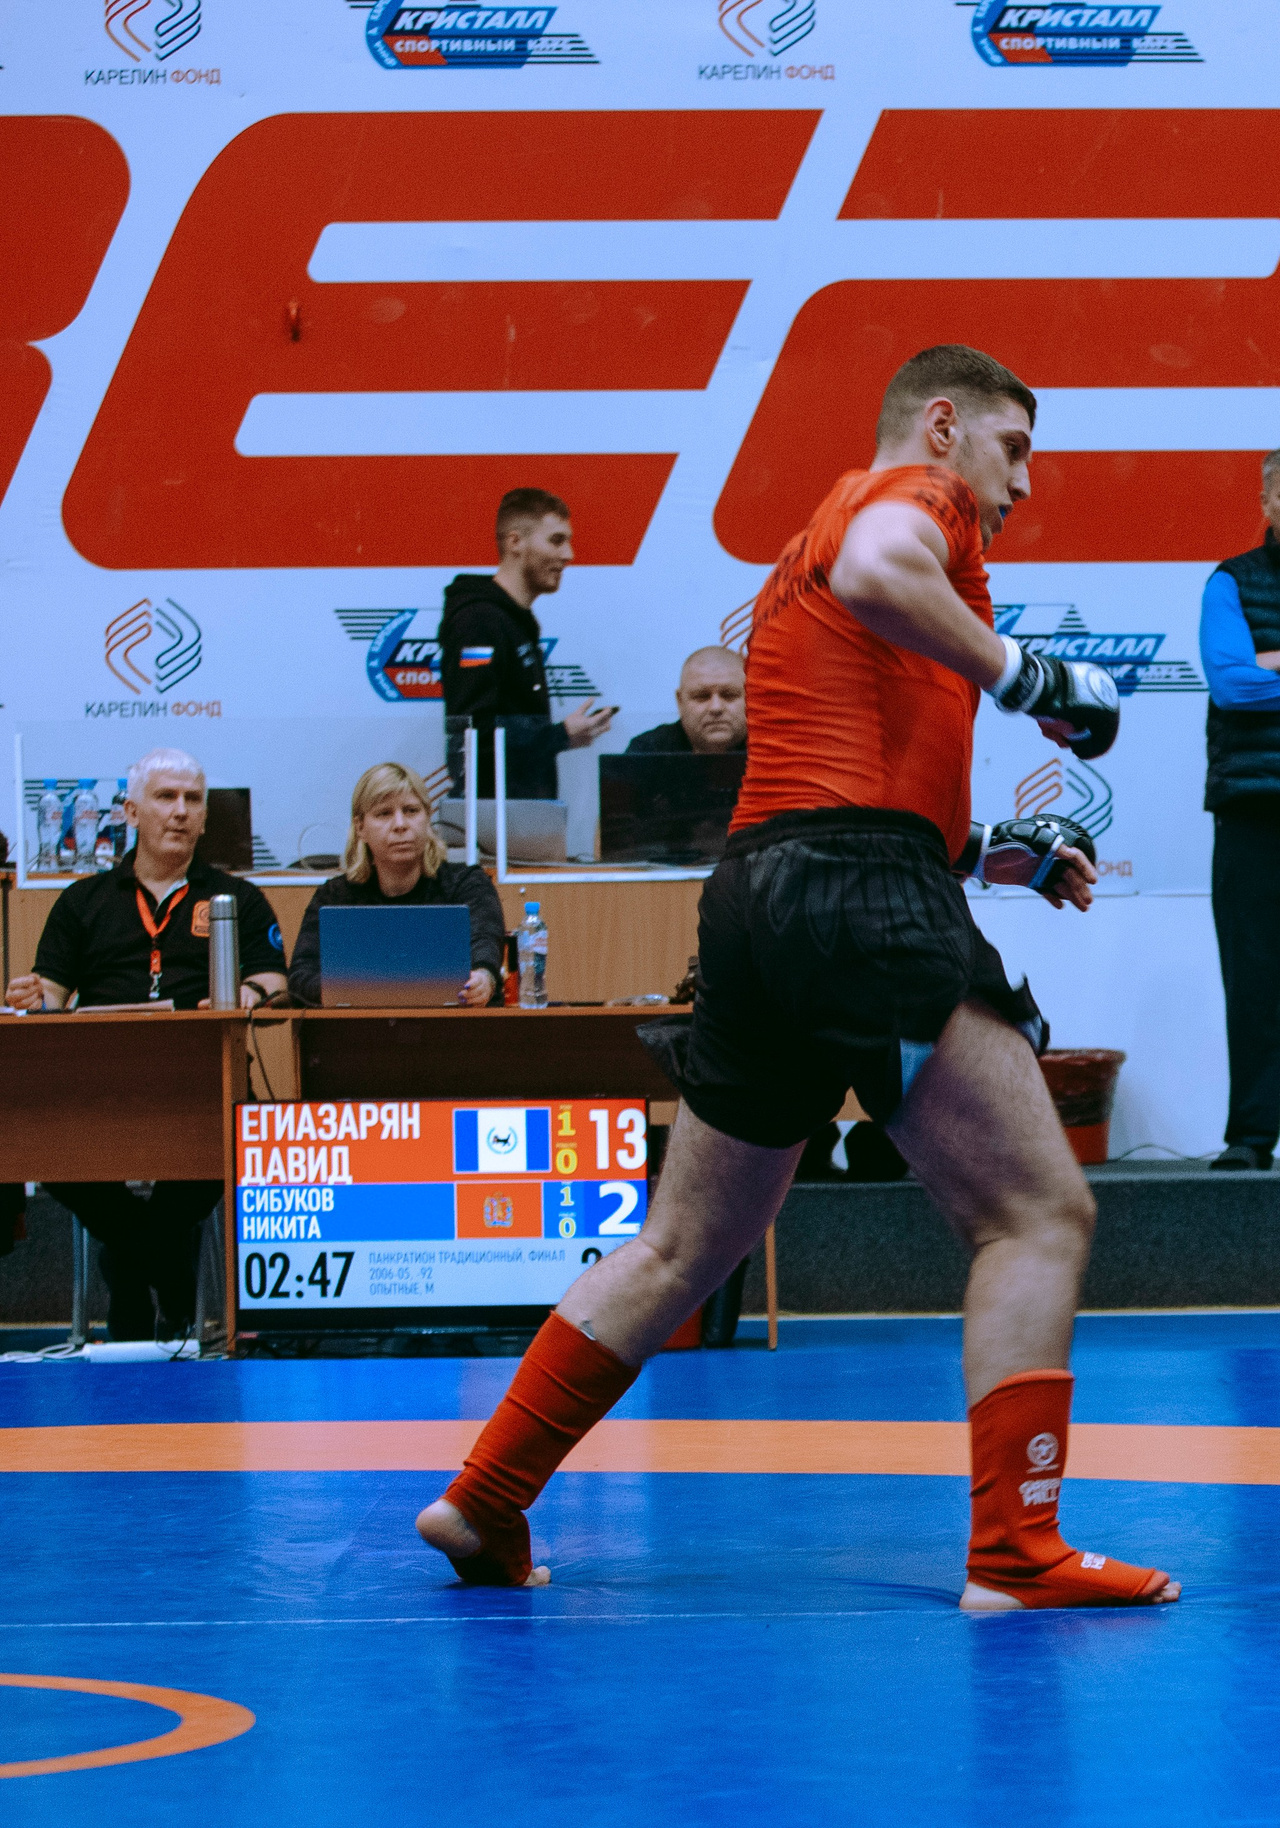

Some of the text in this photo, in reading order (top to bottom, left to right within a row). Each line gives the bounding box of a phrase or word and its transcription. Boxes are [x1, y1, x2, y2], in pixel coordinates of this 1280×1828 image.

[393, 10, 550, 31] КРИСТАЛЛ
[999, 8, 1153, 28] КРИСТАЛЛ
[394, 38, 516, 52] СПОРТИВНЫЙ
[1000, 37, 1121, 50] СПОРТИВНЫЙ
[84, 68, 222, 86] КАРЕЛИН ФОНД
[699, 64, 835, 81] КАРЕЛИН ФОНД
[85, 700, 222, 718] КАРЕЛИН ФОНД
[1097, 860, 1133, 878] ОНД
[241, 1102, 421, 1142] ЕГИАЗАРЯН
[557, 1110, 576, 1137] 1
[589, 1108, 648, 1170] 13
[240, 1145, 353, 1187] ДАВИД
[555, 1147, 578, 1175] 0
[242, 1188, 335, 1213] СИБУКОВ
[560, 1186, 575, 1207] 1
[598, 1181, 643, 1236] 2
[243, 1215, 321, 1240] НИКИТА
[558, 1216, 577, 1239] 0
[369, 1251, 435, 1265] ПАНКРАТИОН
[528, 1249, 566, 1263] ФИНАЛ
[244, 1251, 355, 1299] 02:47
